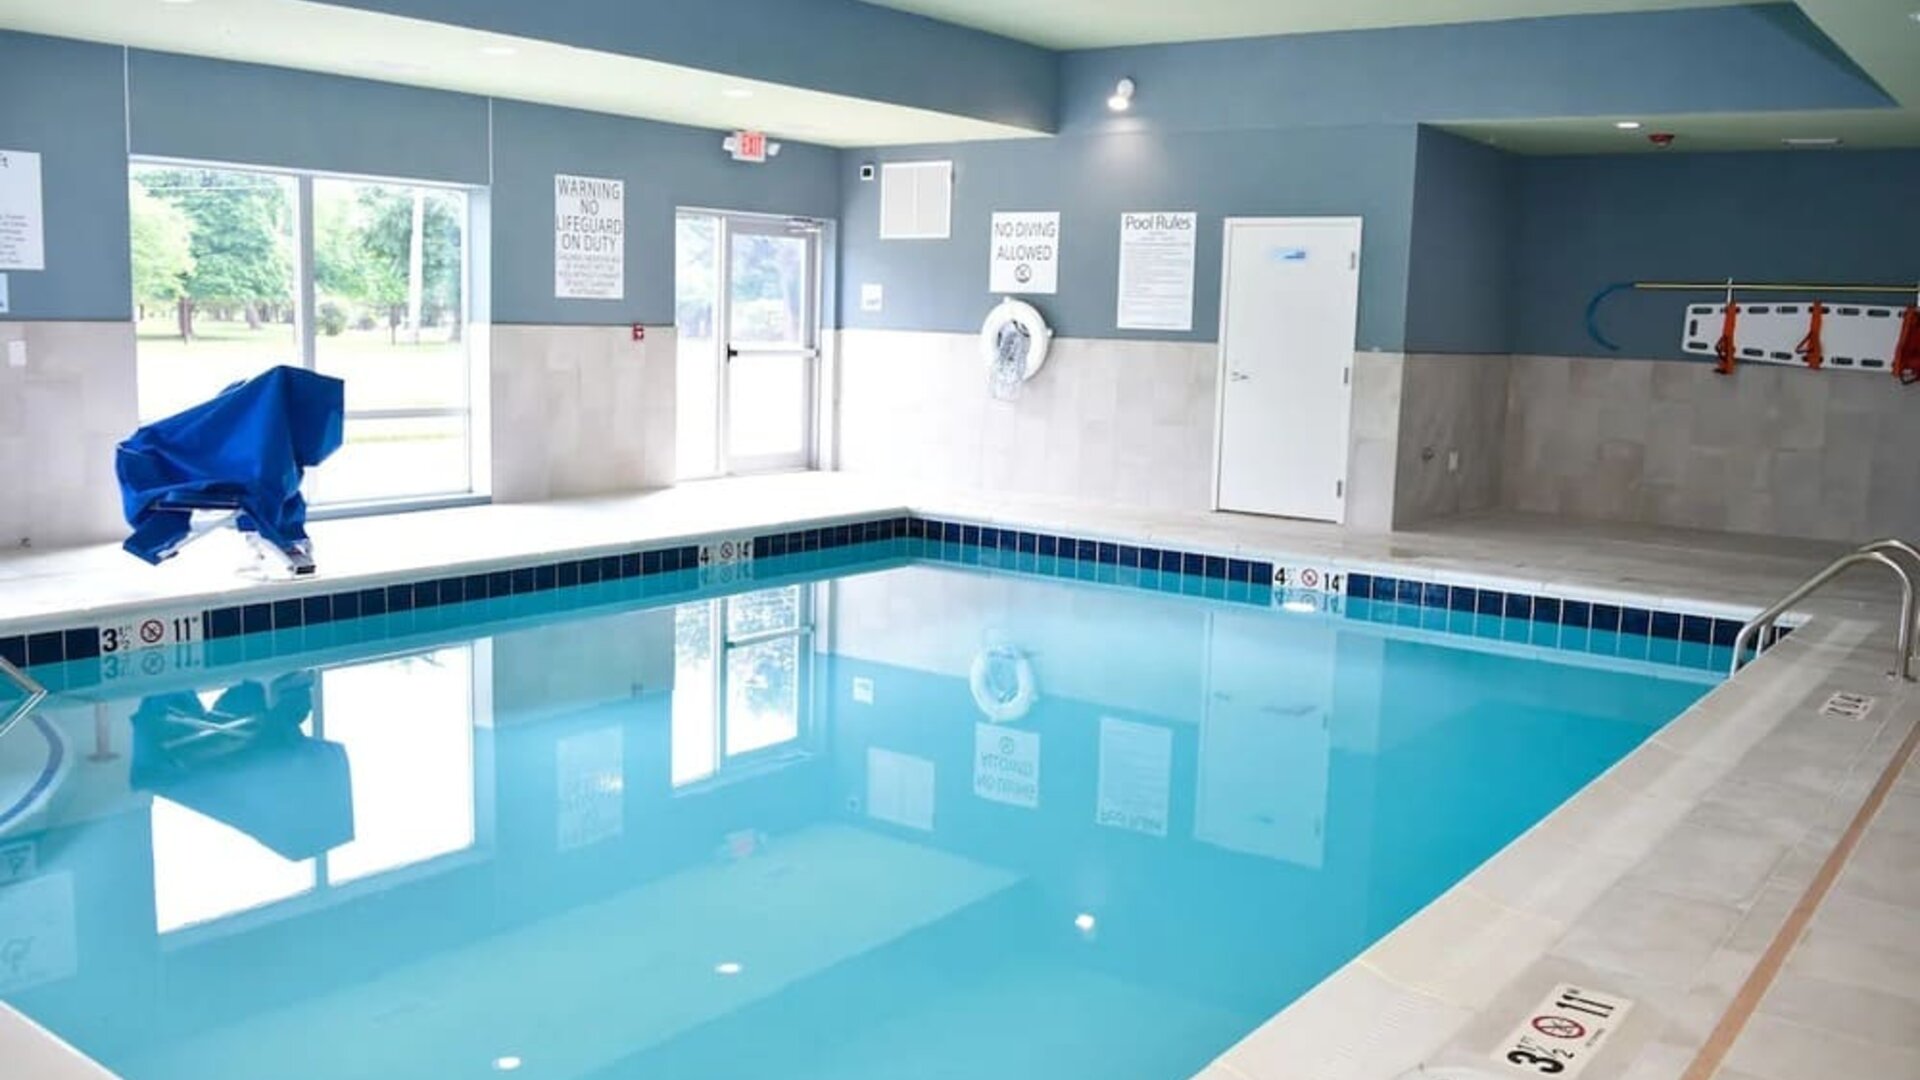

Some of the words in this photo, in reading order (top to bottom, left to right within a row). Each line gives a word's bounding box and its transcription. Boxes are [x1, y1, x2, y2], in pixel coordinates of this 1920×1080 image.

[741, 133, 763, 158] EXIT
[558, 178, 620, 200] WARNING
[580, 199, 600, 216] NO
[556, 214, 622, 235] LIFEGUARD
[995, 221, 1014, 238] NO
[1015, 220, 1056, 238] DIVING
[1125, 215, 1153, 230] Pool
[1156, 214, 1191, 230] Rules
[561, 233, 580, 250] ON
[583, 234, 616, 252] DUTY
[995, 244, 1052, 261] ALLOWED
